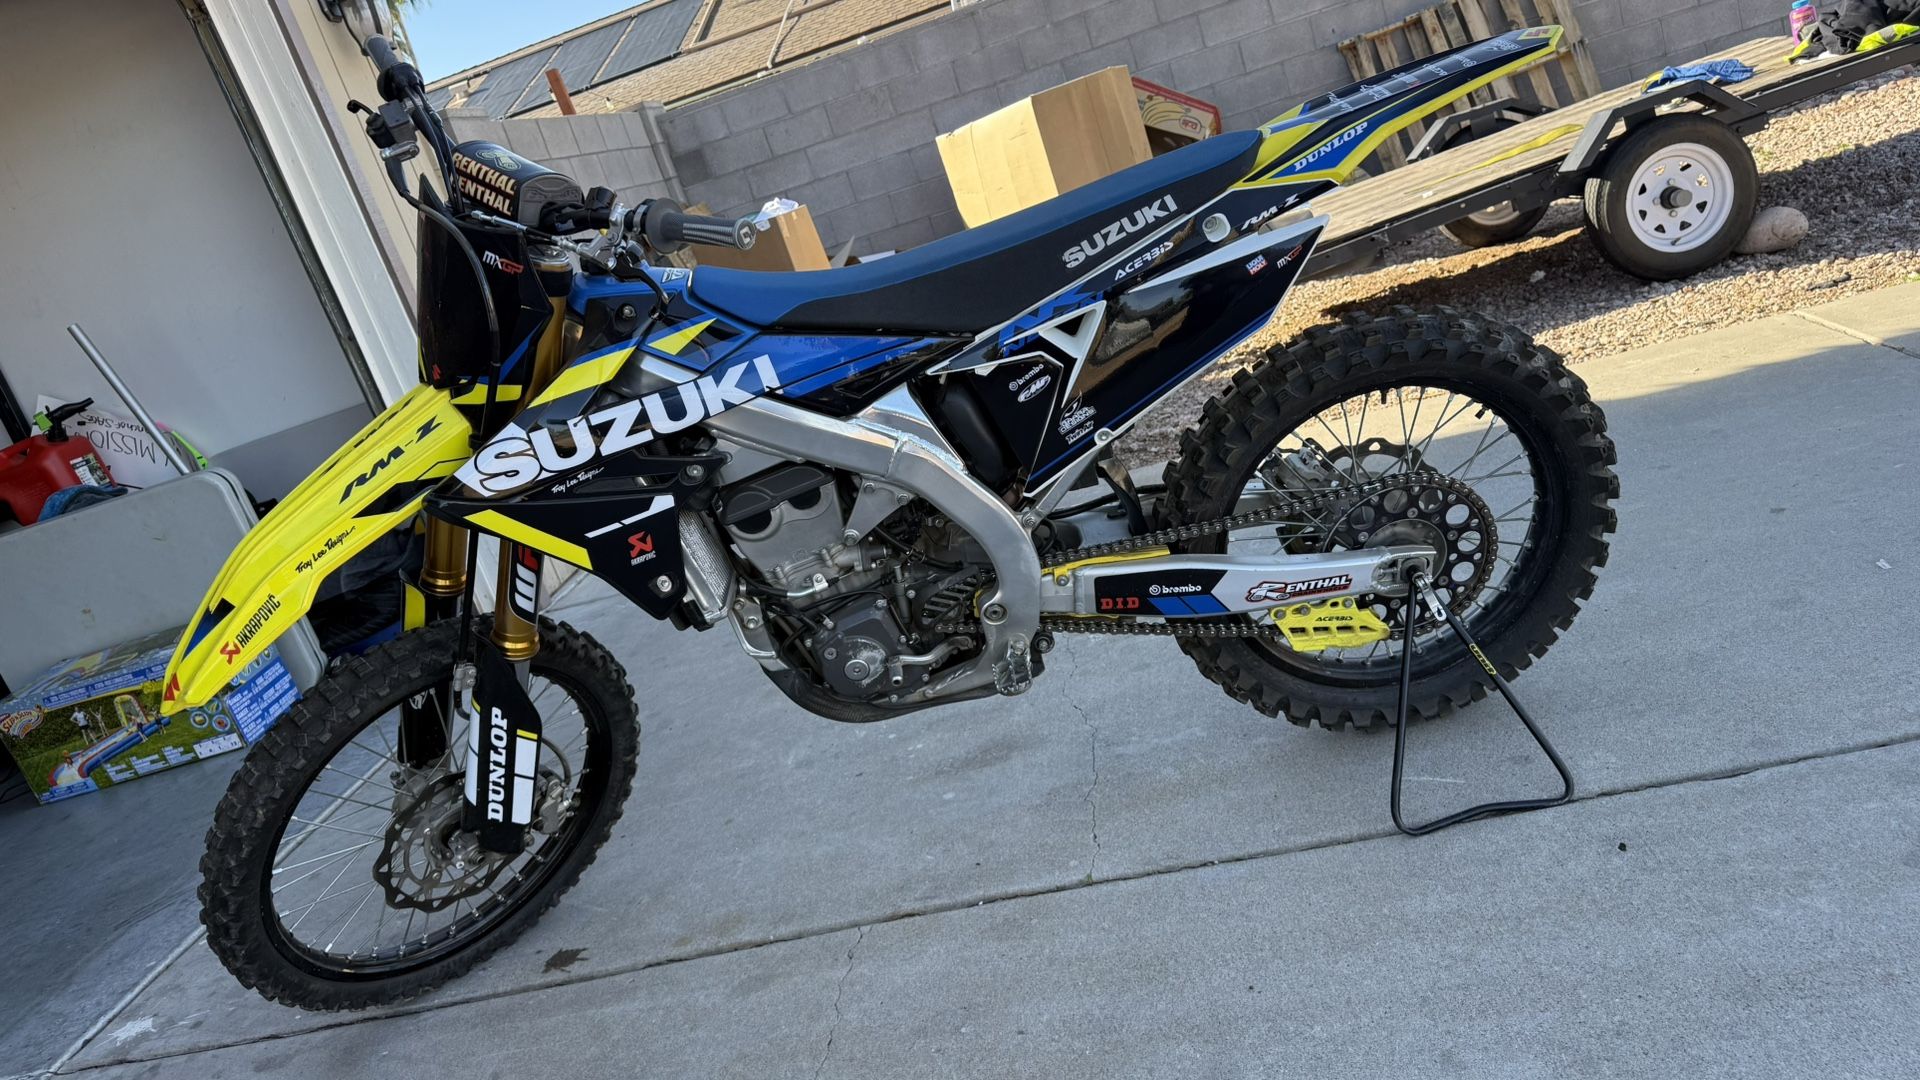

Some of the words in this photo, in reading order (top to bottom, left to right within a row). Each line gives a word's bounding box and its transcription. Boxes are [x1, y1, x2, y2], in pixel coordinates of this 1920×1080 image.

[1293, 121, 1368, 172] DUNLOP
[451, 173, 512, 216] ENTHAL
[452, 152, 515, 195] RENTHAL
[1062, 194, 1178, 269] SUZUKI
[1240, 193, 1300, 231] RM-Z
[482, 250, 524, 275] MXGP
[1114, 240, 1174, 281] ACERBIS
[1017, 363, 1044, 385] brembo
[473, 354, 784, 493] SUZUKI
[339, 415, 443, 505] RM-Z
[551, 484, 566, 493] Troy
[566, 479, 579, 488] Lee
[295, 561, 313, 573] Troy
[312, 553, 327, 562] Lee
[324, 525, 357, 551] Designs
[1162, 583, 1202, 595] brembo
[1248, 575, 1351, 600] RENTHAL
[487, 706, 509, 823] DUNLOP
